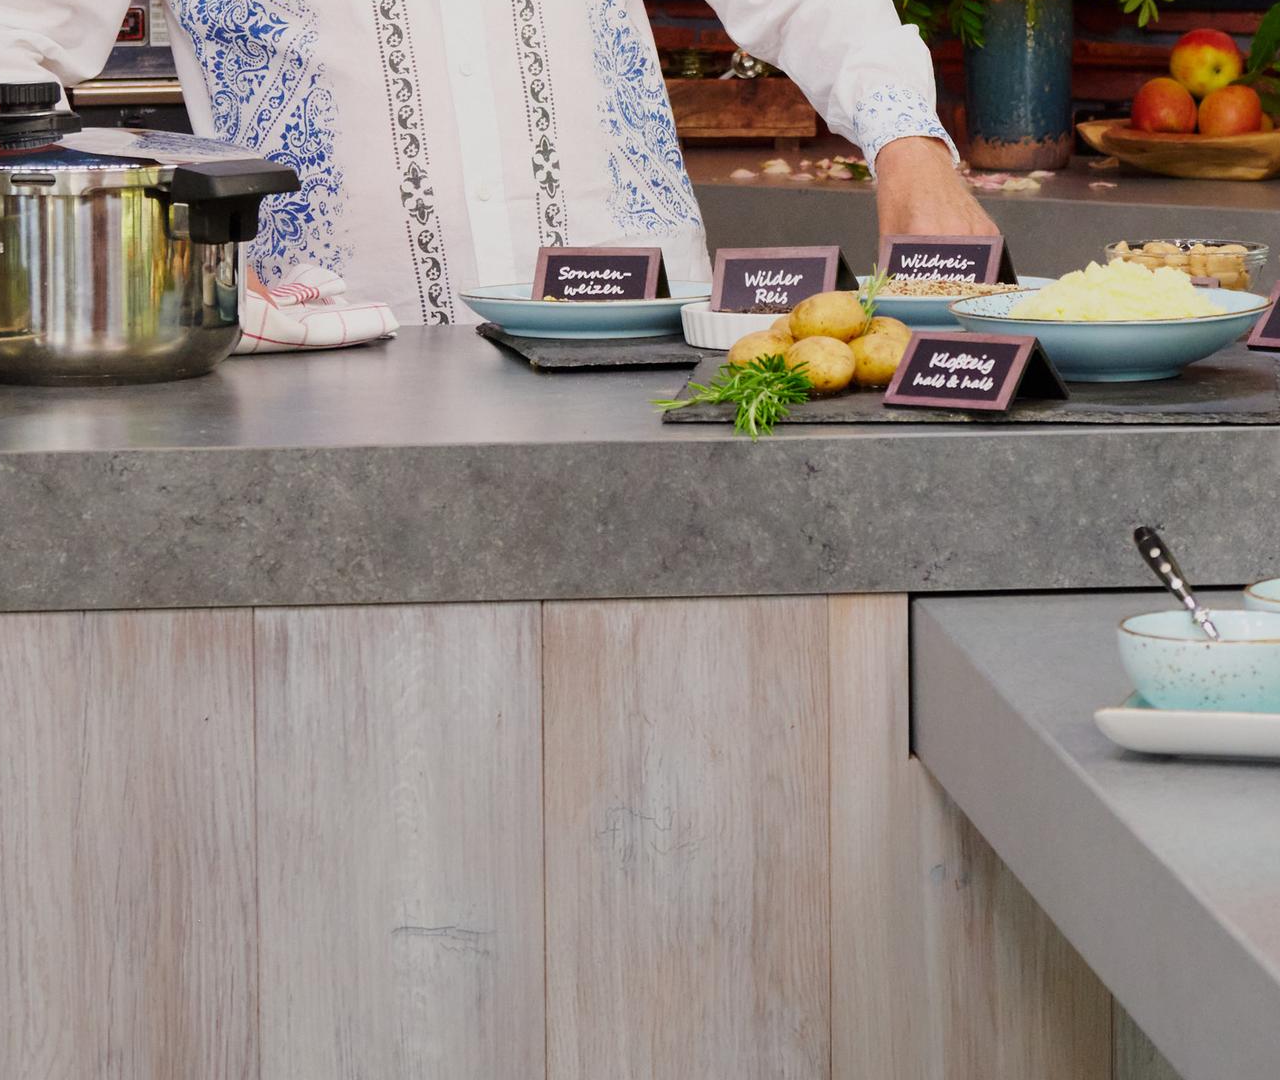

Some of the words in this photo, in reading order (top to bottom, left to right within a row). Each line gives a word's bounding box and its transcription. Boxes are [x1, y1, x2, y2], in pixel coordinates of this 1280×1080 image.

[901, 253, 976, 270] Wildreis-
[558, 266, 632, 281] Sonnen-
[744, 270, 803, 288] Wilder
[564, 281, 625, 296] weizen
[754, 287, 788, 304] Reis
[928, 352, 995, 375] Kloßteig
[912, 372, 946, 388] halb
[946, 374, 960, 388] &
[960, 375, 994, 391] halb
